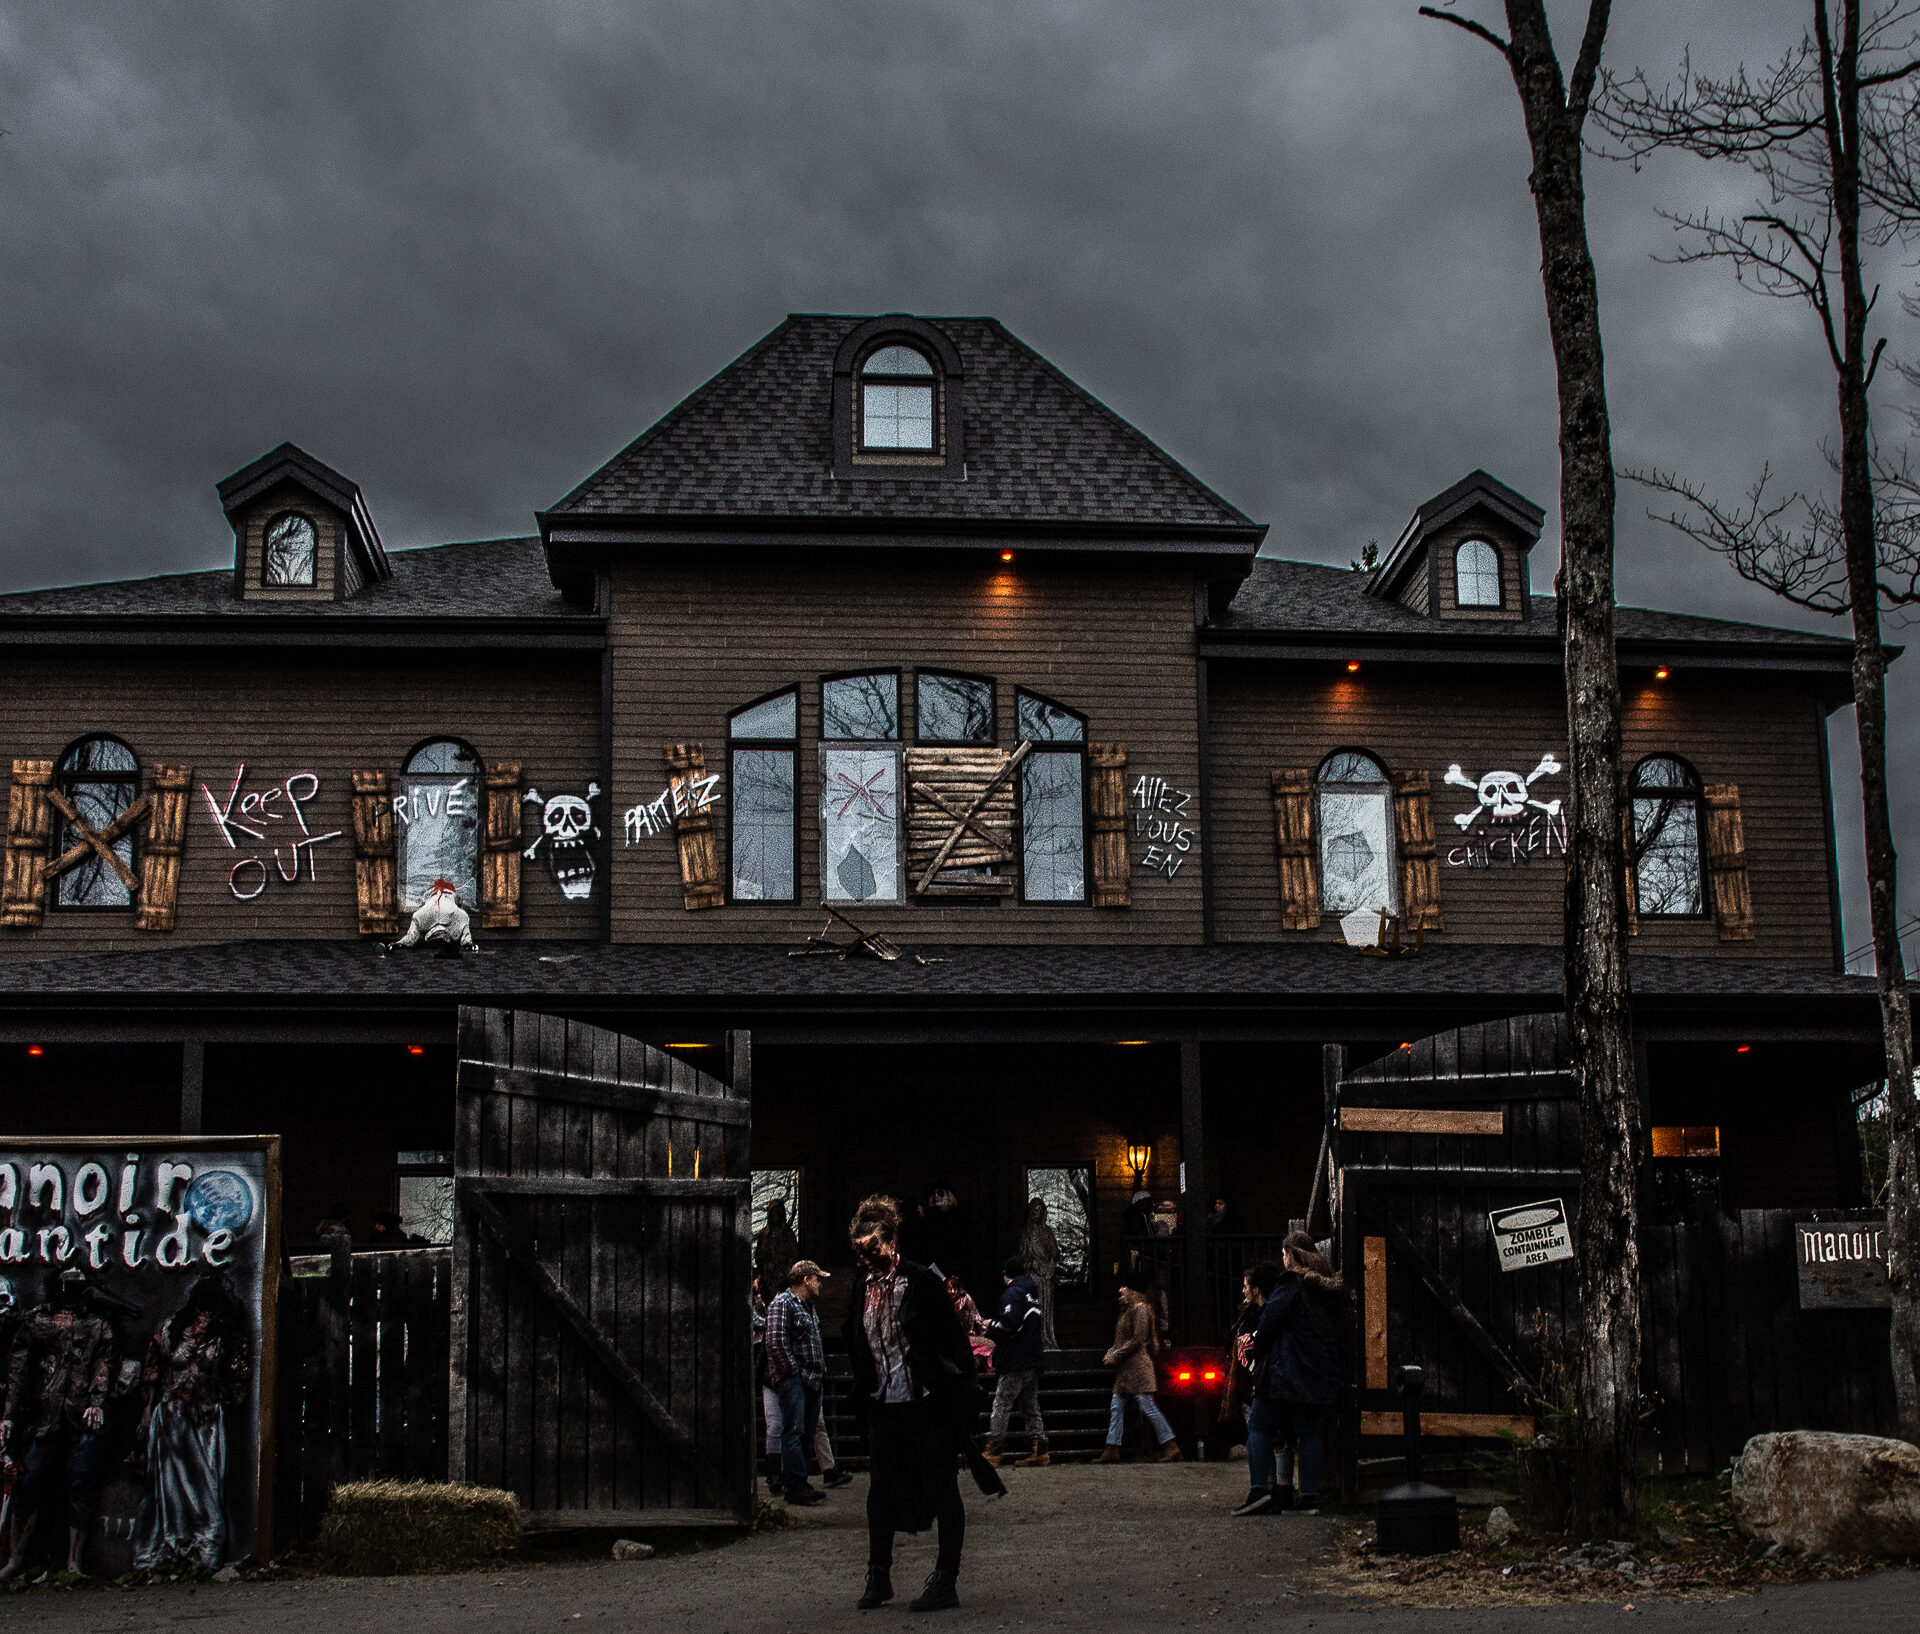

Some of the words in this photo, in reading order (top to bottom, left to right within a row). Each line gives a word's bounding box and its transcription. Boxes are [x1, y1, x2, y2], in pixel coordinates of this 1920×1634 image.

[1136, 814, 1195, 852] VOUS
[229, 831, 342, 899] OUT
[1142, 845, 1182, 880] EN
[1502, 1236, 1565, 1258] CONTAINMENT
[1510, 1226, 1555, 1245] ZOMBIE
[1525, 1251, 1549, 1265] AREA
